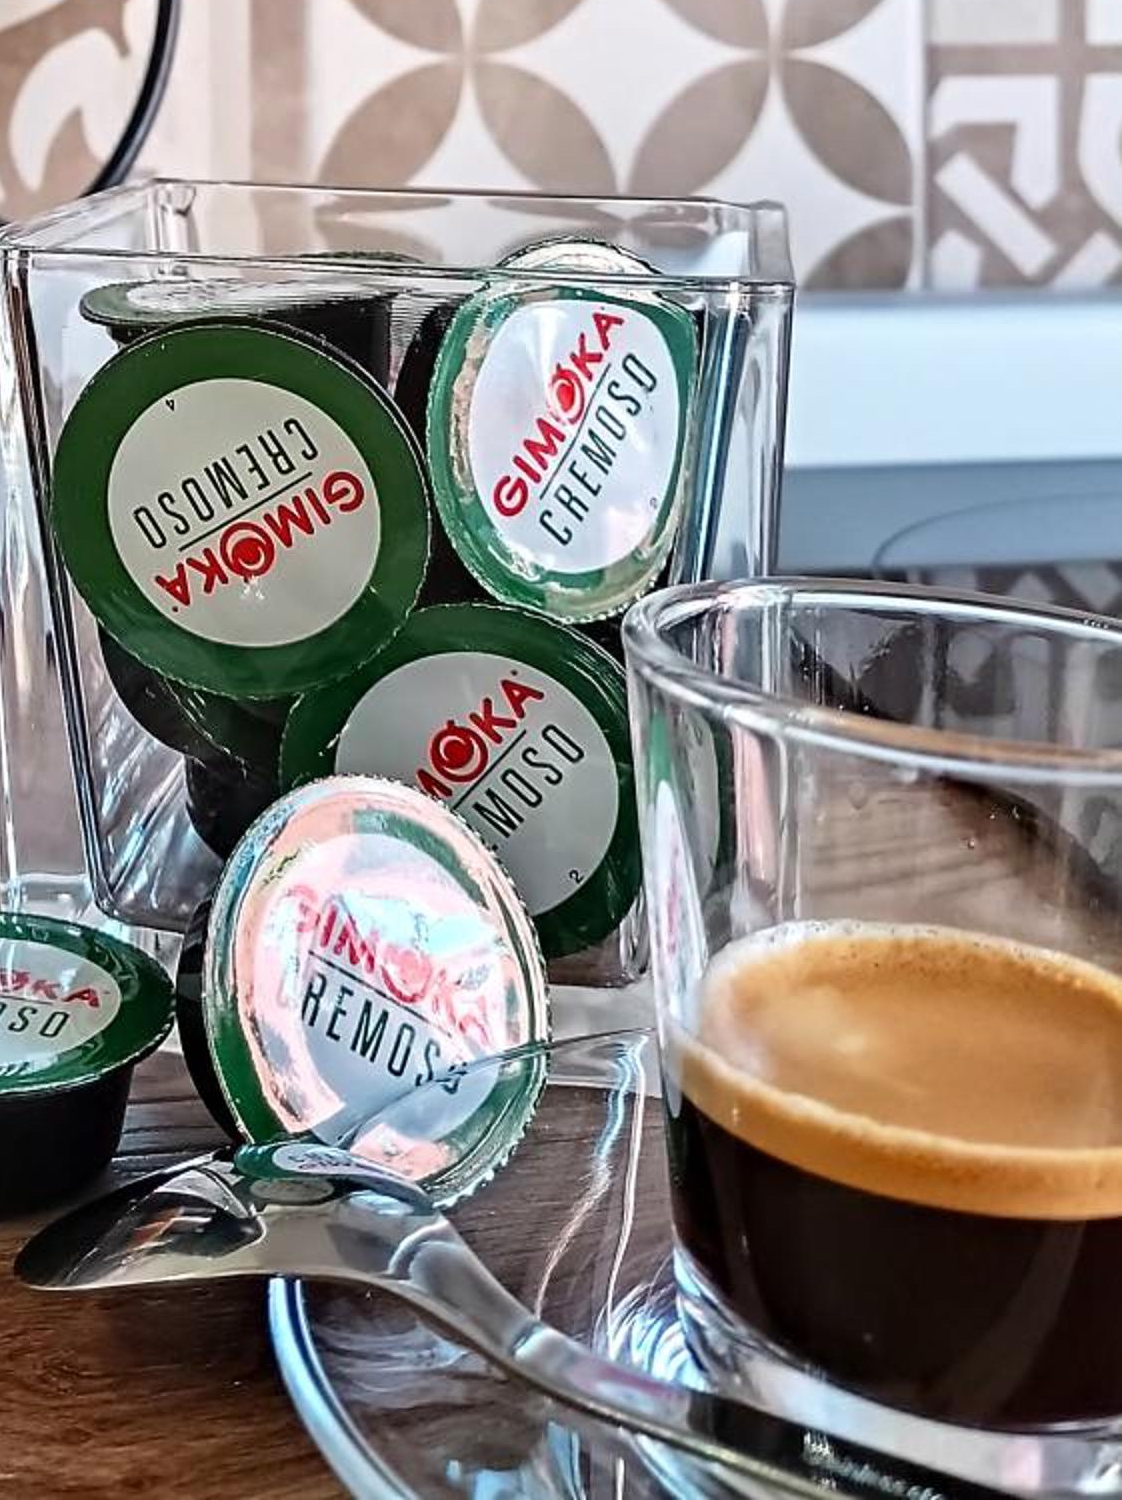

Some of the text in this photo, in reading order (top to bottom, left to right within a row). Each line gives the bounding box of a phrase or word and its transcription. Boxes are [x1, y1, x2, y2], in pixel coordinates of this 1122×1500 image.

[493, 310, 625, 517] GIMOKA
[539, 353, 657, 546] CREMOSO
[133, 418, 319, 550] CREMOSO
[154, 471, 365, 607] GIMOKA
[474, 724, 585, 838] MOSO
[569, 869, 585, 884] 2
